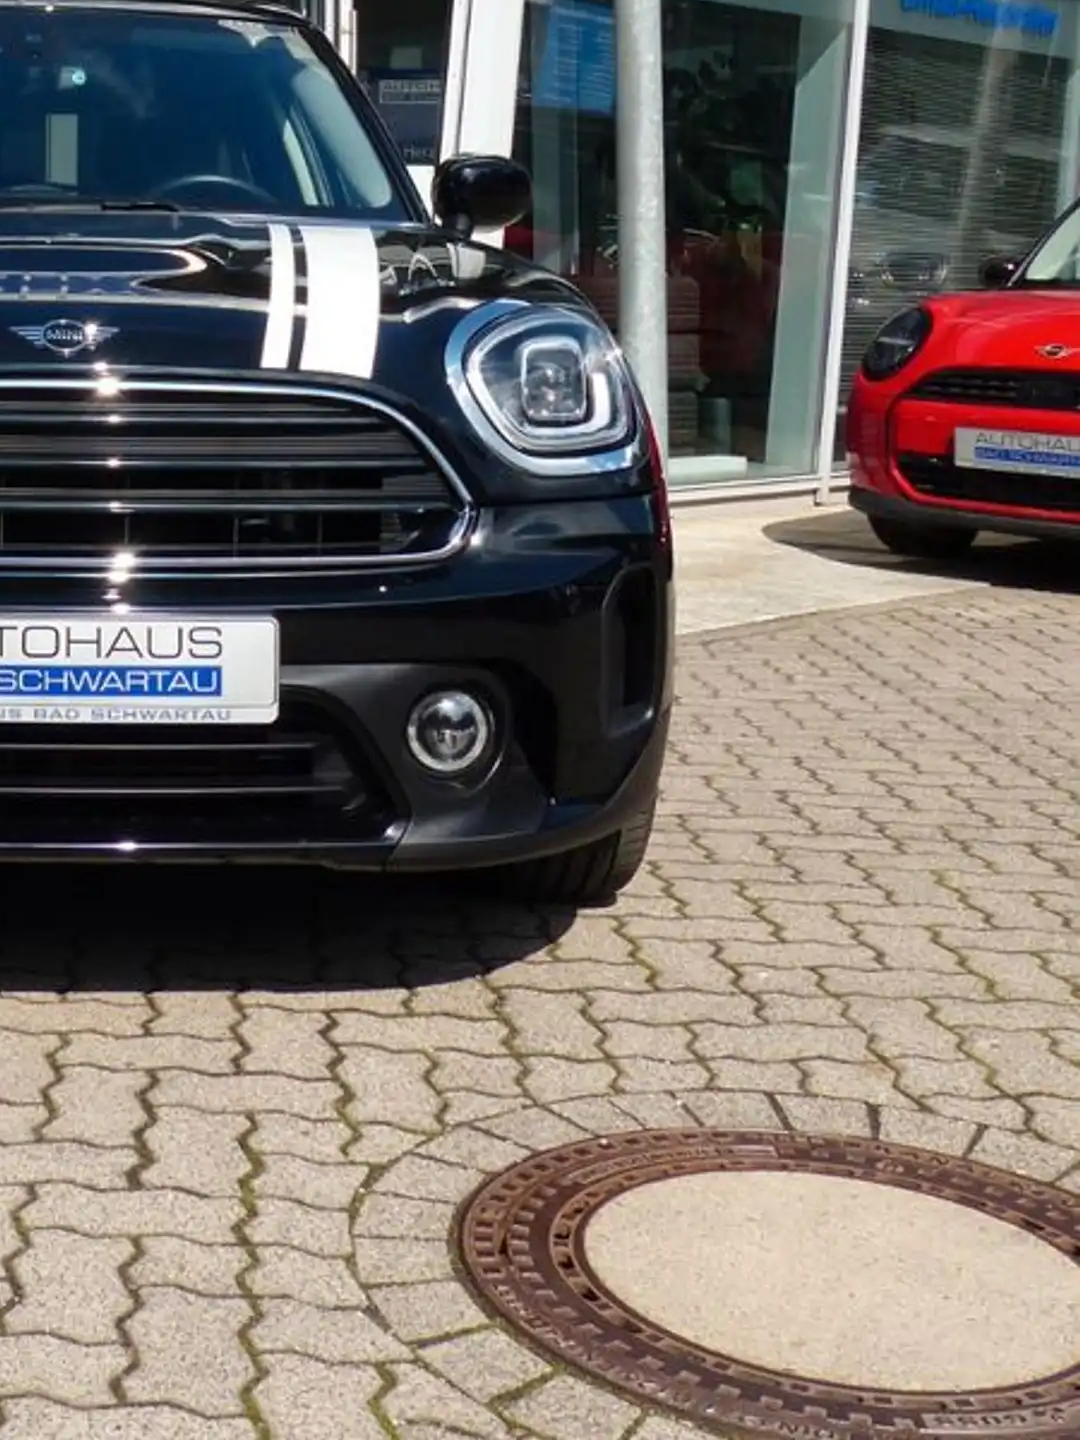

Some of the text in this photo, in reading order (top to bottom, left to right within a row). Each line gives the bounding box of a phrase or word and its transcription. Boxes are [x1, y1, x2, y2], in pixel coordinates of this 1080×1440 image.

[46, 329, 84, 341] MINI
[33, 708, 80, 720] BAD
[90, 708, 232, 721] SCHWARTAU
